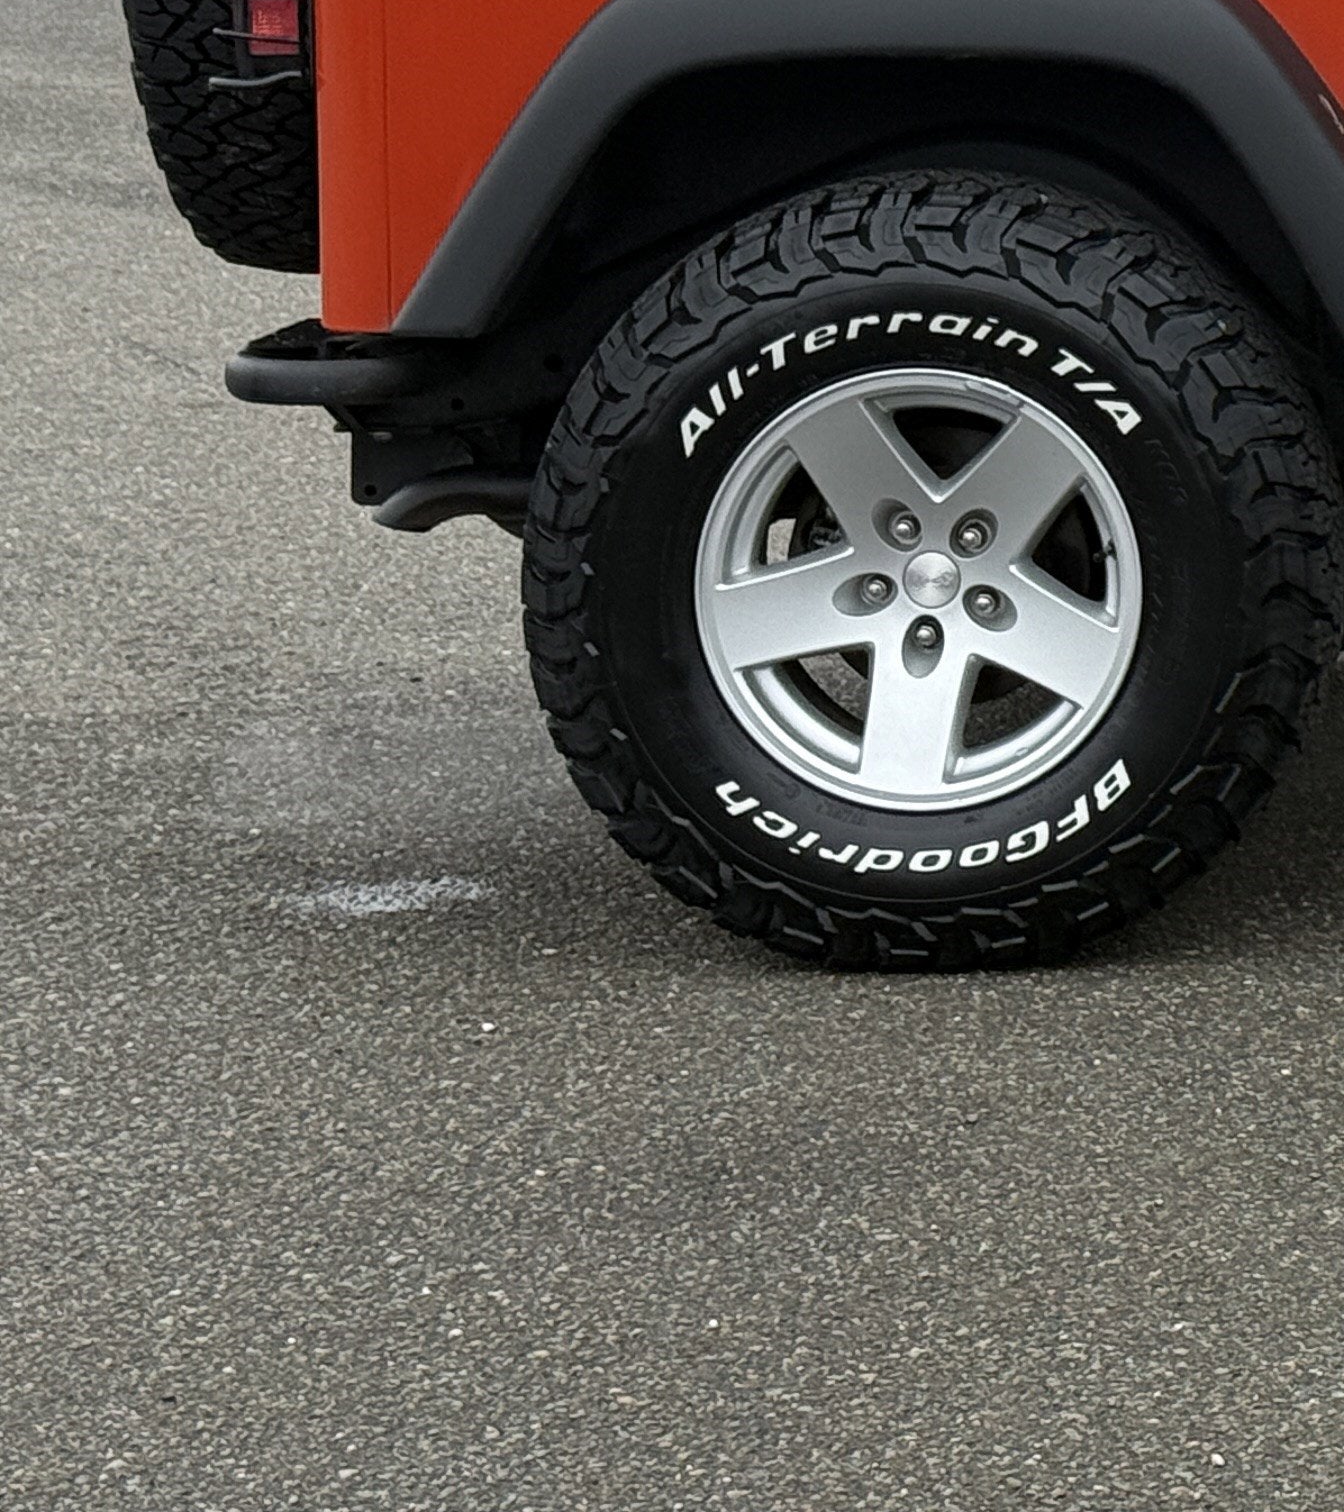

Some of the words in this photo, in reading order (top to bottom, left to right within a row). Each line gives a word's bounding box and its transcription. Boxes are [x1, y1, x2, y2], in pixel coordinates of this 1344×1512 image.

[679, 308, 1040, 458] All-Terrain
[1050, 348, 1144, 437] T/A
[715, 756, 1132, 874] BFGoodrich
